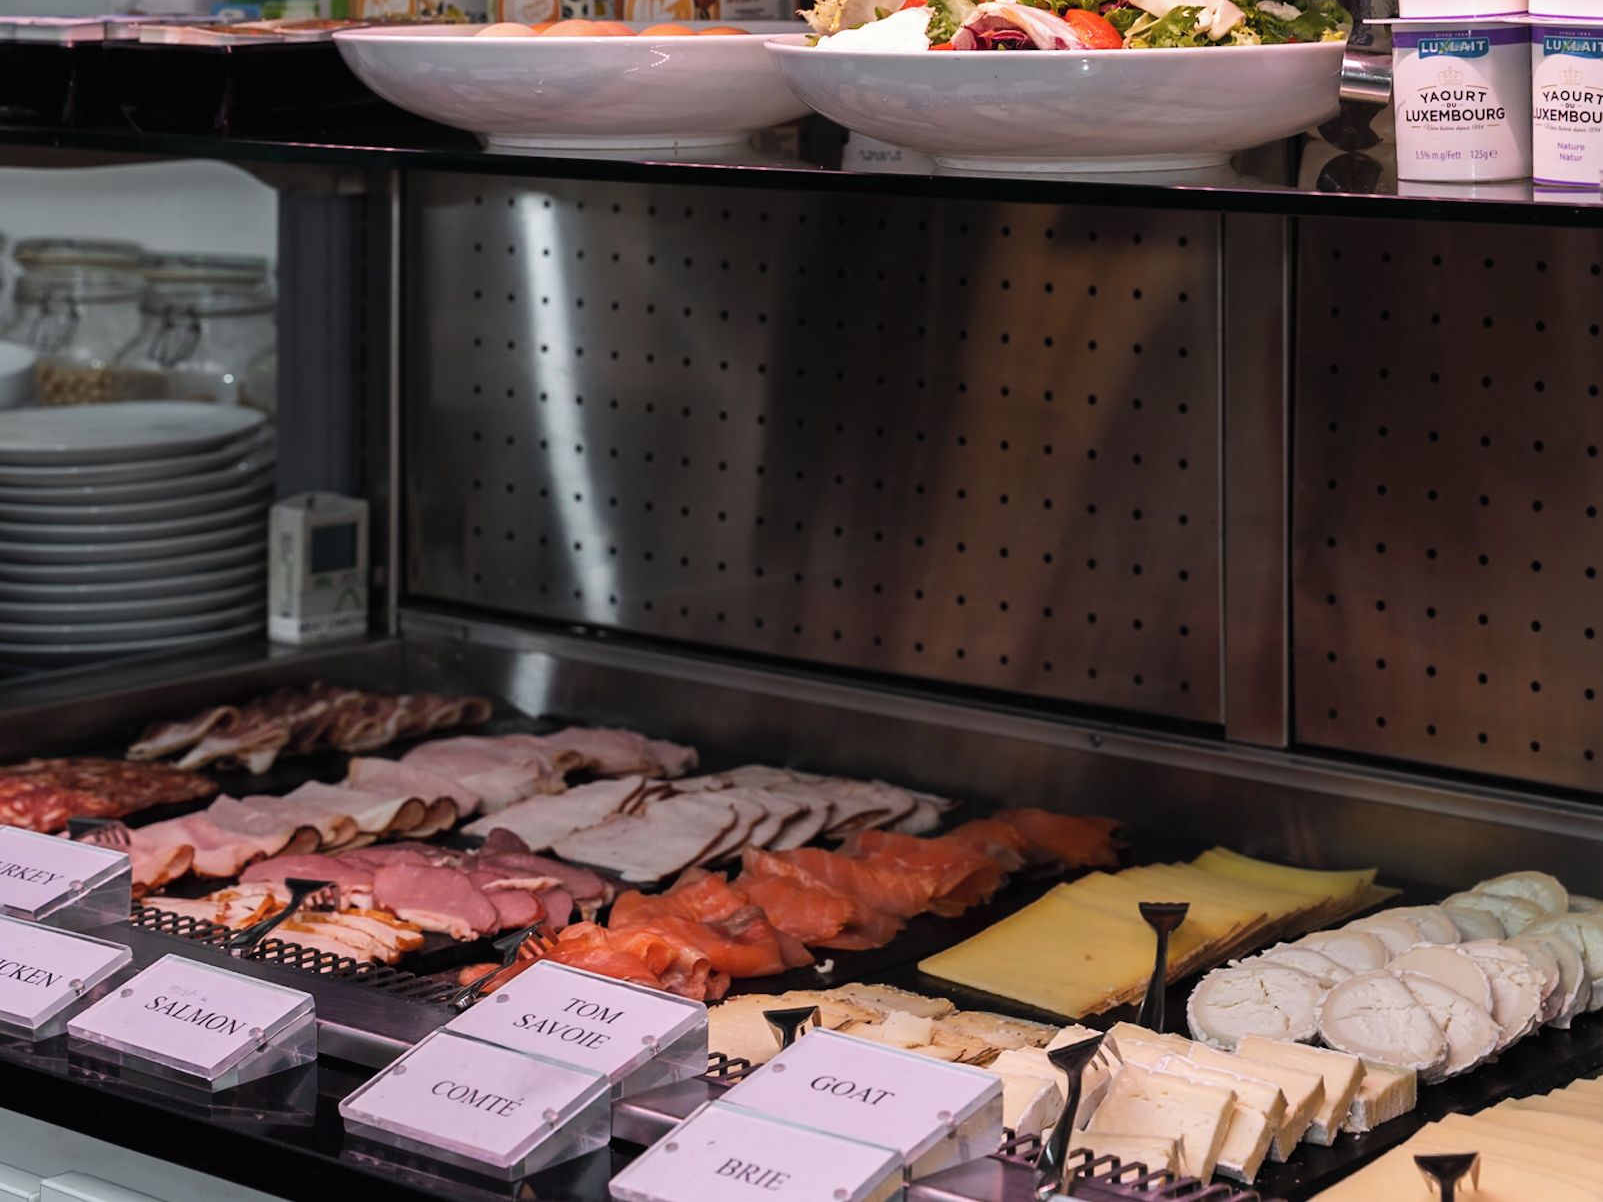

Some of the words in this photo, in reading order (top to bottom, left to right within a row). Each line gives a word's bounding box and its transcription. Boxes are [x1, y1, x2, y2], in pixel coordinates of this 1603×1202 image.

[1421, 40, 1485, 55] LUXLAIT
[1420, 90, 1487, 104] YAOURT
[1542, 90, 1603, 105] YAOURT
[1405, 107, 1505, 122] LUXEMBOURG
[1533, 108, 1603, 124] UXEMBOU
[1557, 142, 1586, 151] Nature
[1559, 153, 1583, 162] Natur
[144, 995, 247, 1036] SALMON
[562, 997, 626, 1025] TOM
[512, 1013, 612, 1050] SAVOIE
[810, 1075, 896, 1106] GOAT
[431, 1080, 526, 1118] COMTÉ
[714, 1157, 792, 1192] BRIE
